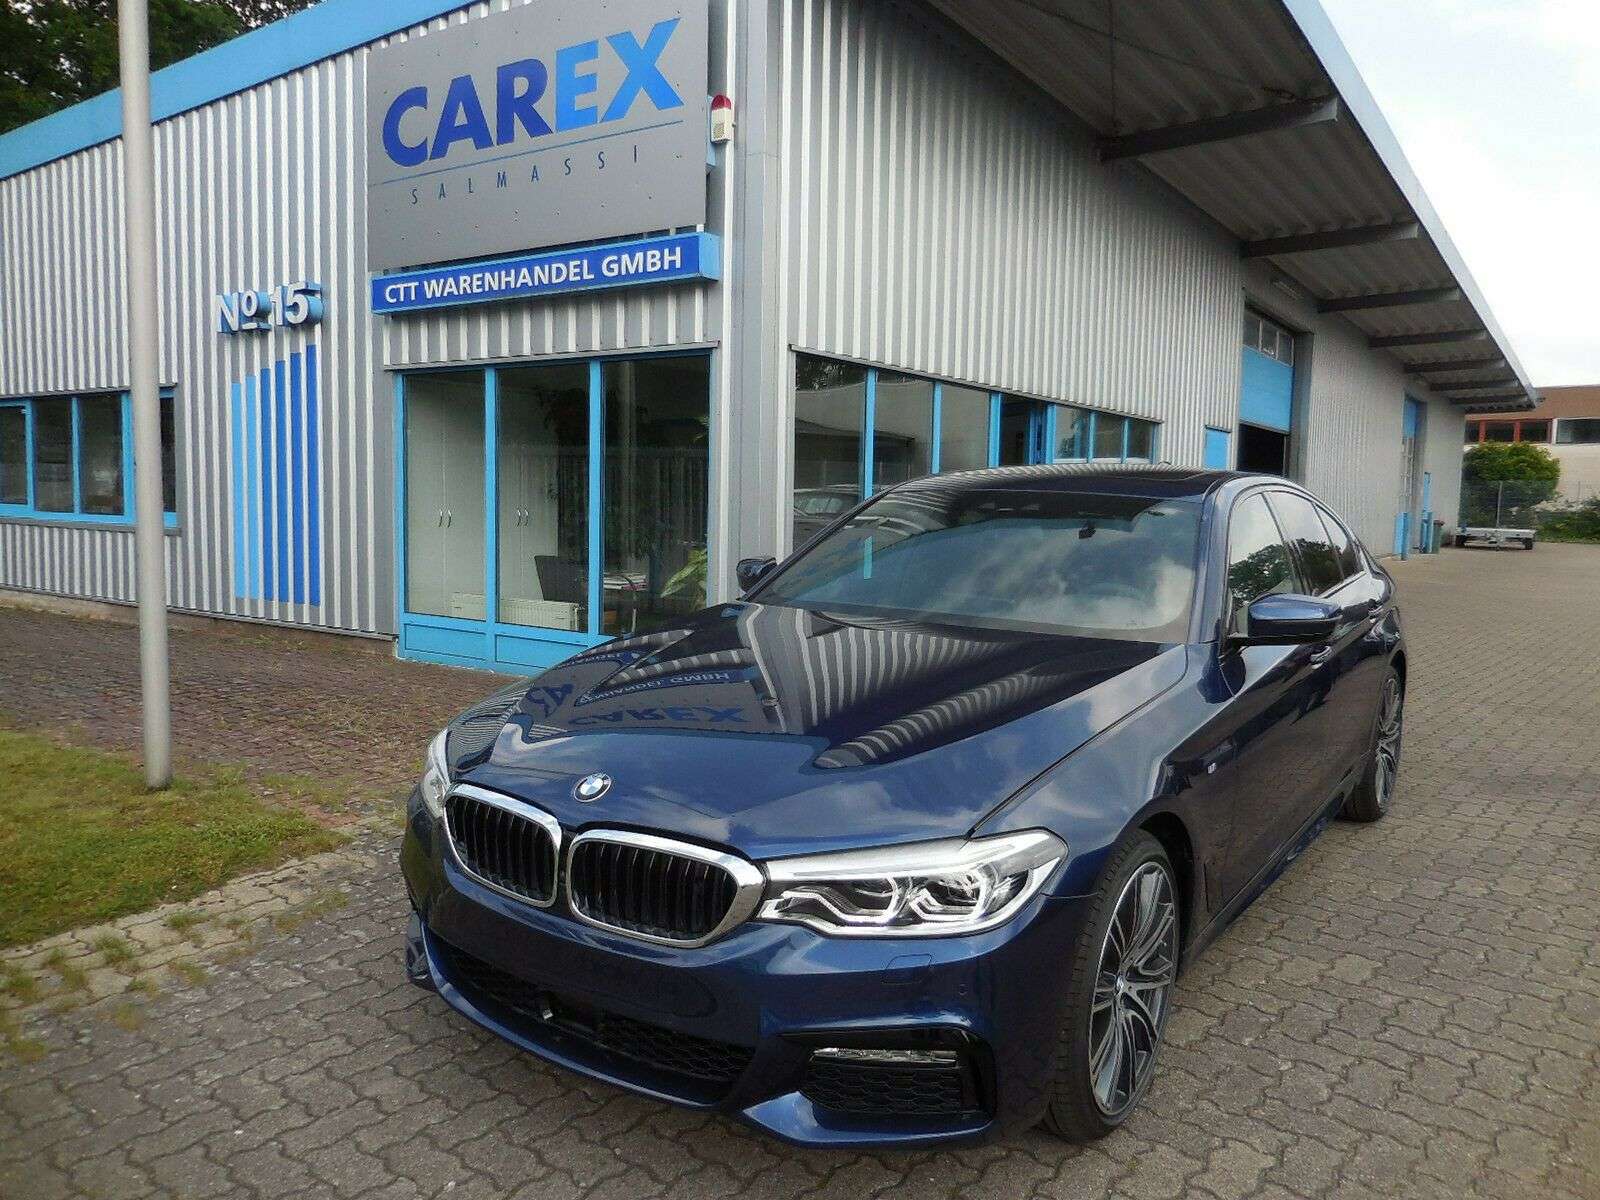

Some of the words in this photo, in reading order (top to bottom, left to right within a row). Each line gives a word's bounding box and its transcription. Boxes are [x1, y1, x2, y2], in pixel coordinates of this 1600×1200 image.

[382, 17, 685, 168] CAREX
[410, 144, 637, 205] SALMASSI
[270, 280, 310, 326] 15
[384, 281, 419, 304] CTT
[423, 259, 595, 299] WARENHANDEL
[601, 246, 682, 278] GMBH
